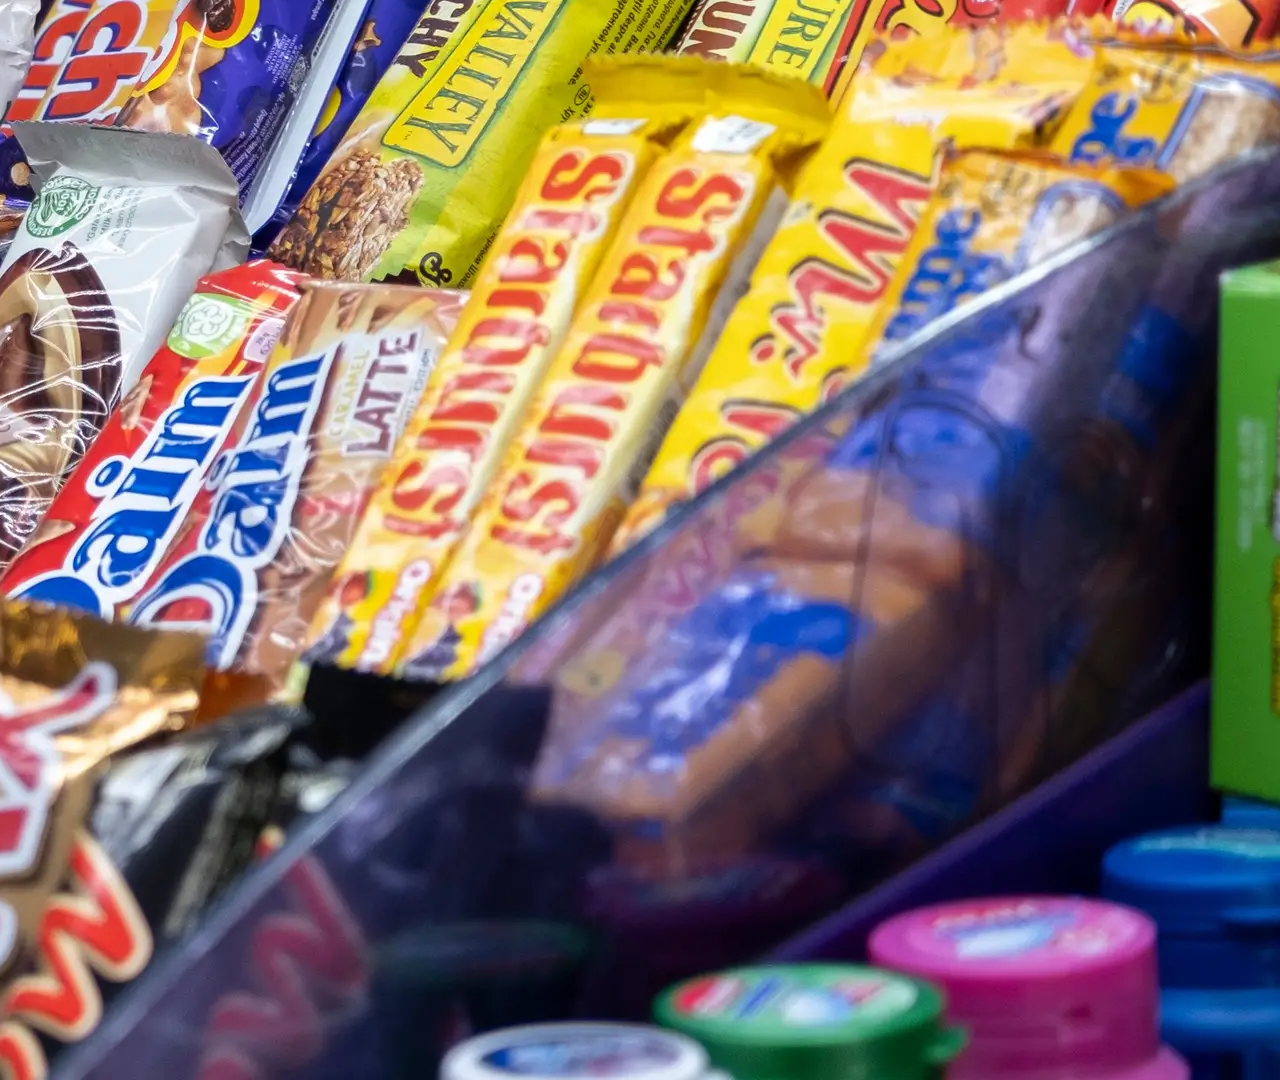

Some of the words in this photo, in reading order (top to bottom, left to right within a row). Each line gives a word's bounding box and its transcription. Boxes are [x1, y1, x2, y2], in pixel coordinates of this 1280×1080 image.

[402, 6, 529, 155] VALLEY
[325, 345, 374, 439] CARAMEL
[346, 327, 422, 457] LATTE
[392, 148, 631, 544] Starburst
[491, 166, 749, 562] Starburst
[131, 343, 342, 670] Daim
